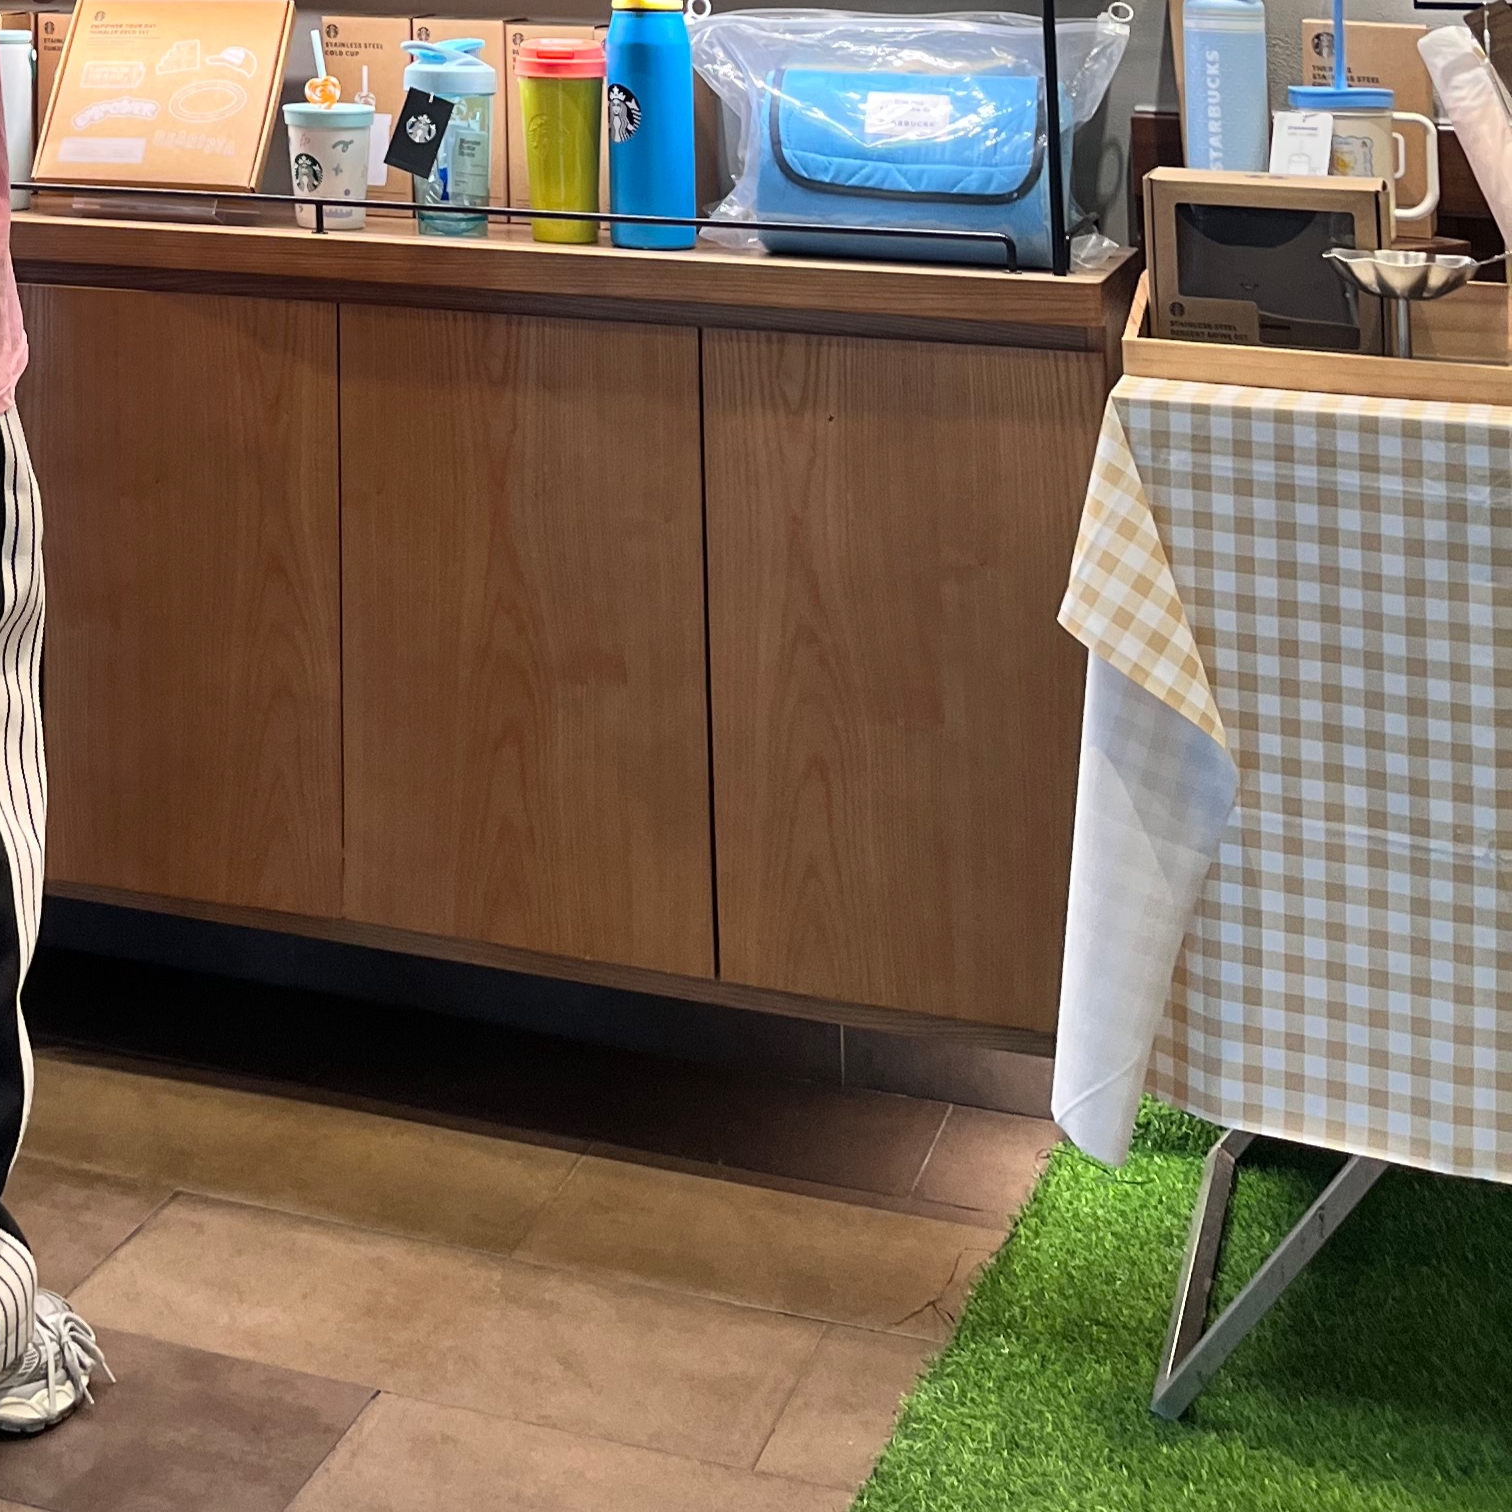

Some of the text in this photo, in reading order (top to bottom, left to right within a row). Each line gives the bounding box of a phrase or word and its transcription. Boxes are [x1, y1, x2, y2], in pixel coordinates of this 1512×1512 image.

[364, 42, 383, 50] STEEL
[1356, 76, 1380, 84] STEEL
[1205, 49, 1224, 170] STARBUCKS
